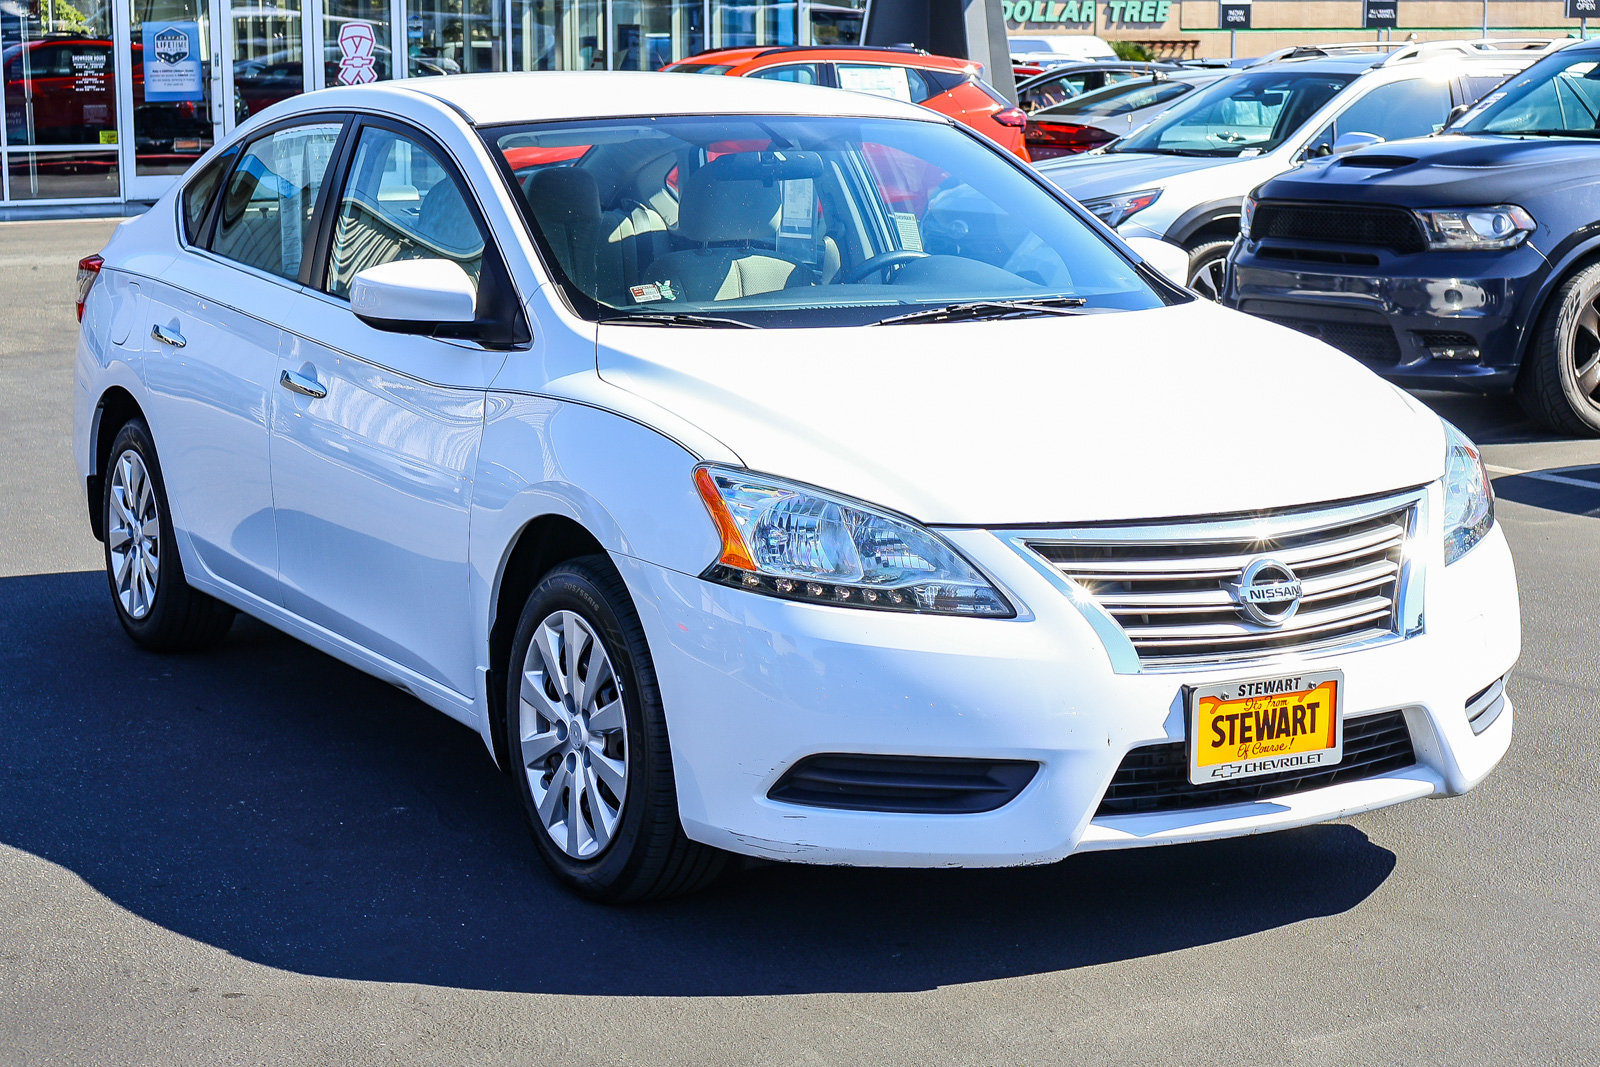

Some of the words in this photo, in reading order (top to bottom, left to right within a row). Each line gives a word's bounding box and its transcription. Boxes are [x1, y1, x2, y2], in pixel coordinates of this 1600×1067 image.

[1002, 0, 1096, 23] DOLLAR
[1109, 0, 1171, 23] TREE
[1576, 2, 1596, 11] OPEN
[156, 41, 187, 49] LIFETIME
[1249, 584, 1300, 600] NISSAN
[1237, 677, 1302, 697] STEWART
[1243, 697, 1263, 712] It's
[1211, 702, 1320, 748] STEWART
[1237, 742, 1251, 761] Of
[1252, 738, 1295, 755] Course!
[1244, 753, 1324, 774] CHEVROLET
